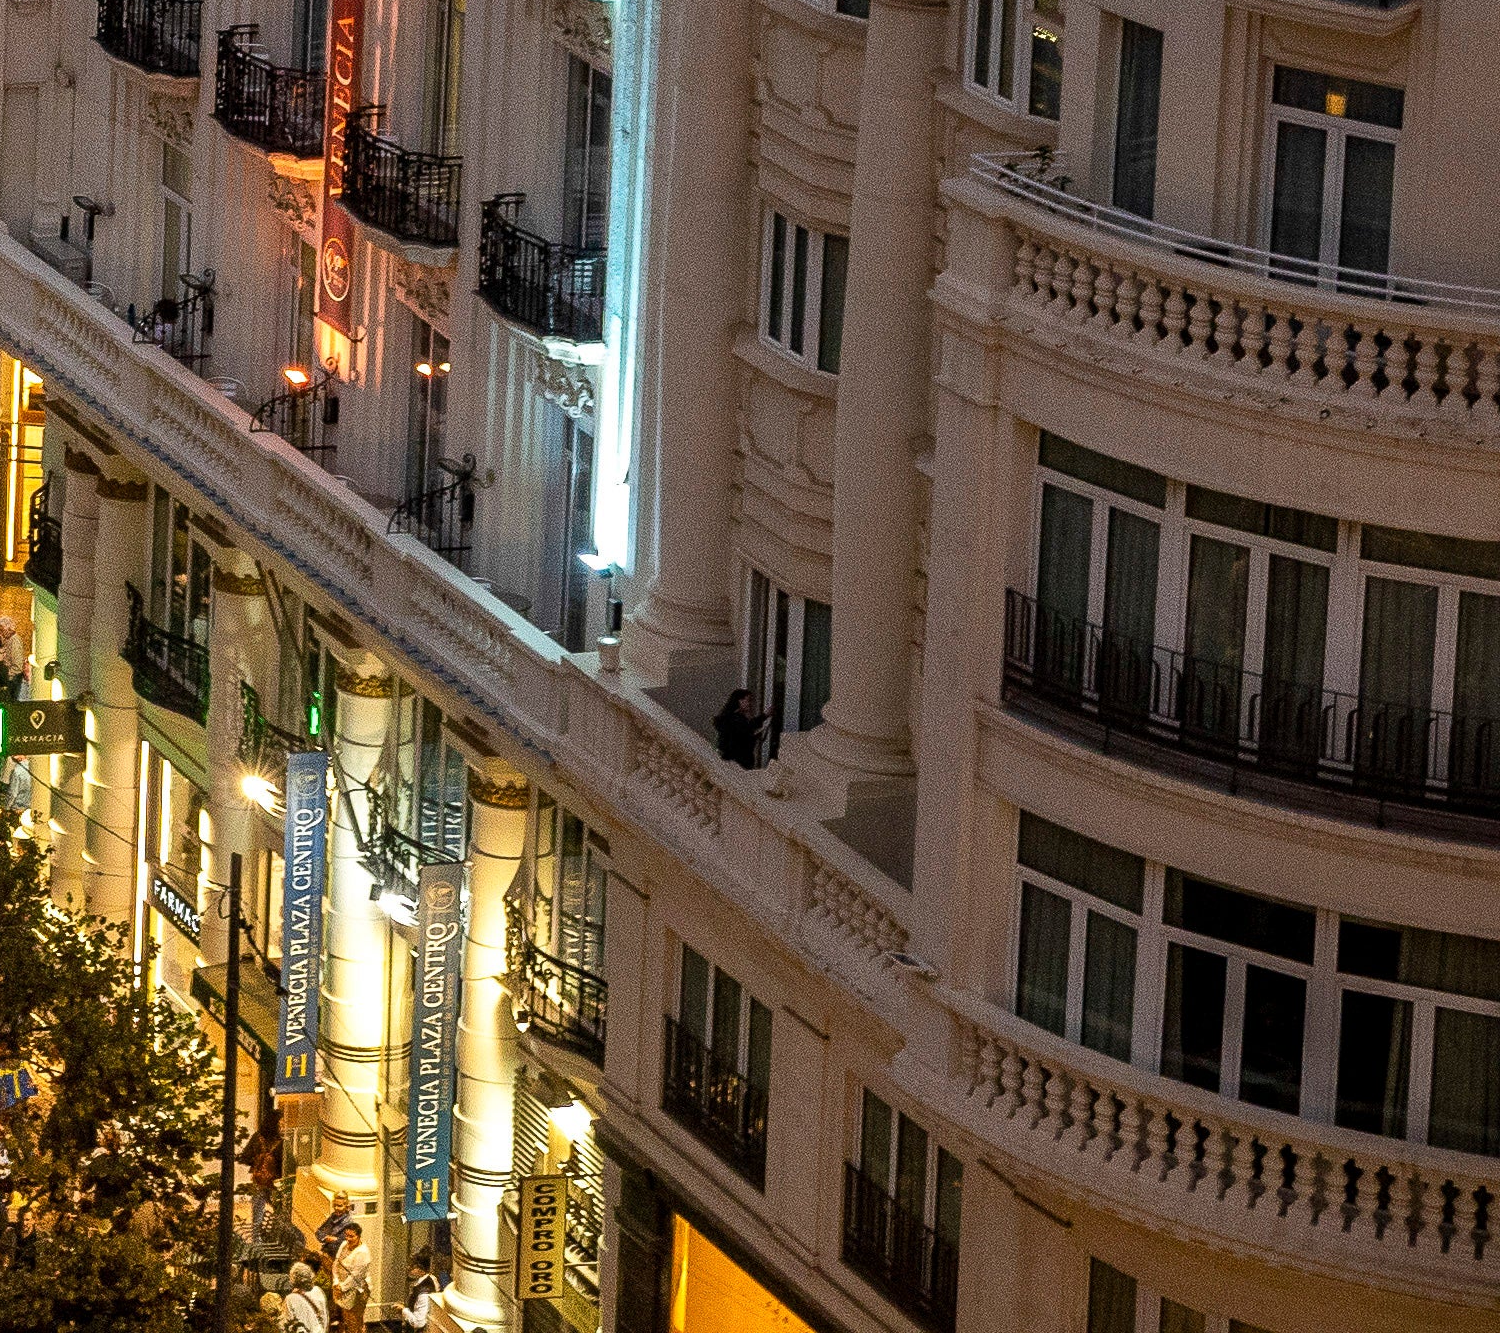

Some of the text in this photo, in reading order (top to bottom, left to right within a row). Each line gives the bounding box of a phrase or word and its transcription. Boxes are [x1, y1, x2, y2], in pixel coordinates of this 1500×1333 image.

[292, 807, 324, 889] CENTRO
[289, 897, 312, 957] PLAZA
[423, 921, 459, 1008] CENTRO
[285, 961, 308, 1046] VENECIA
[419, 1012, 443, 1076] PLAZA
[415, 1082, 440, 1170] VENECIA
[529, 1183, 557, 1294] COMPRO ORO
